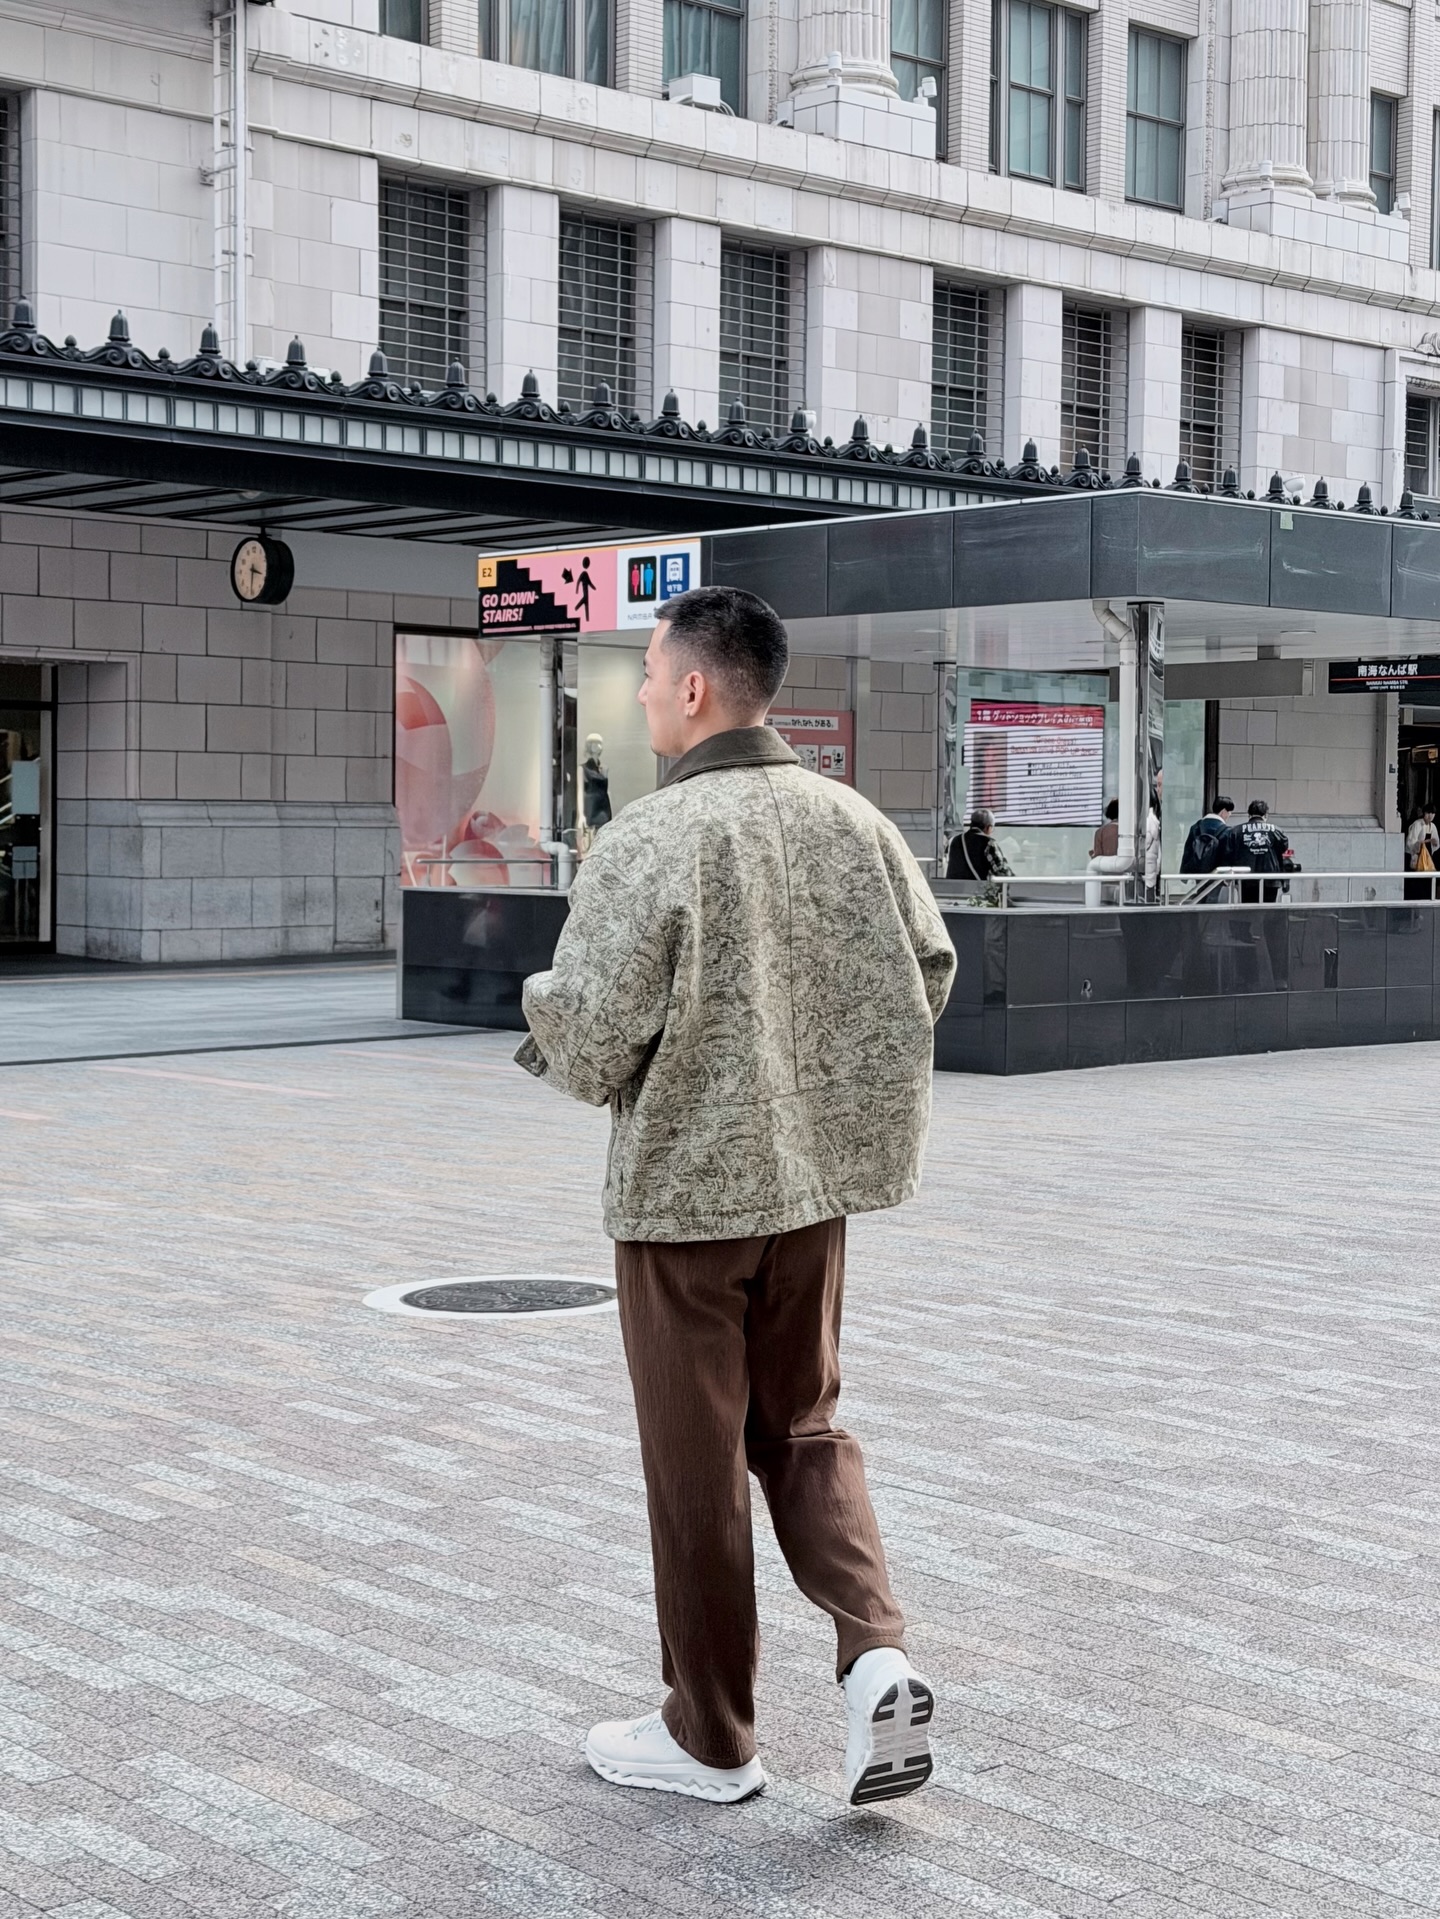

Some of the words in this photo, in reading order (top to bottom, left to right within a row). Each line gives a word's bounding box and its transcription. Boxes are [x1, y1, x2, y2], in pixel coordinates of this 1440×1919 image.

[482, 568, 492, 577] E2
[482, 594, 498, 608] GO
[500, 591, 539, 606] DOWN-
[482, 608, 523, 623] STAIRS!
[1358, 664, 1418, 677] 南海なんば駅
[1242, 823, 1275, 832] PEANUTS
